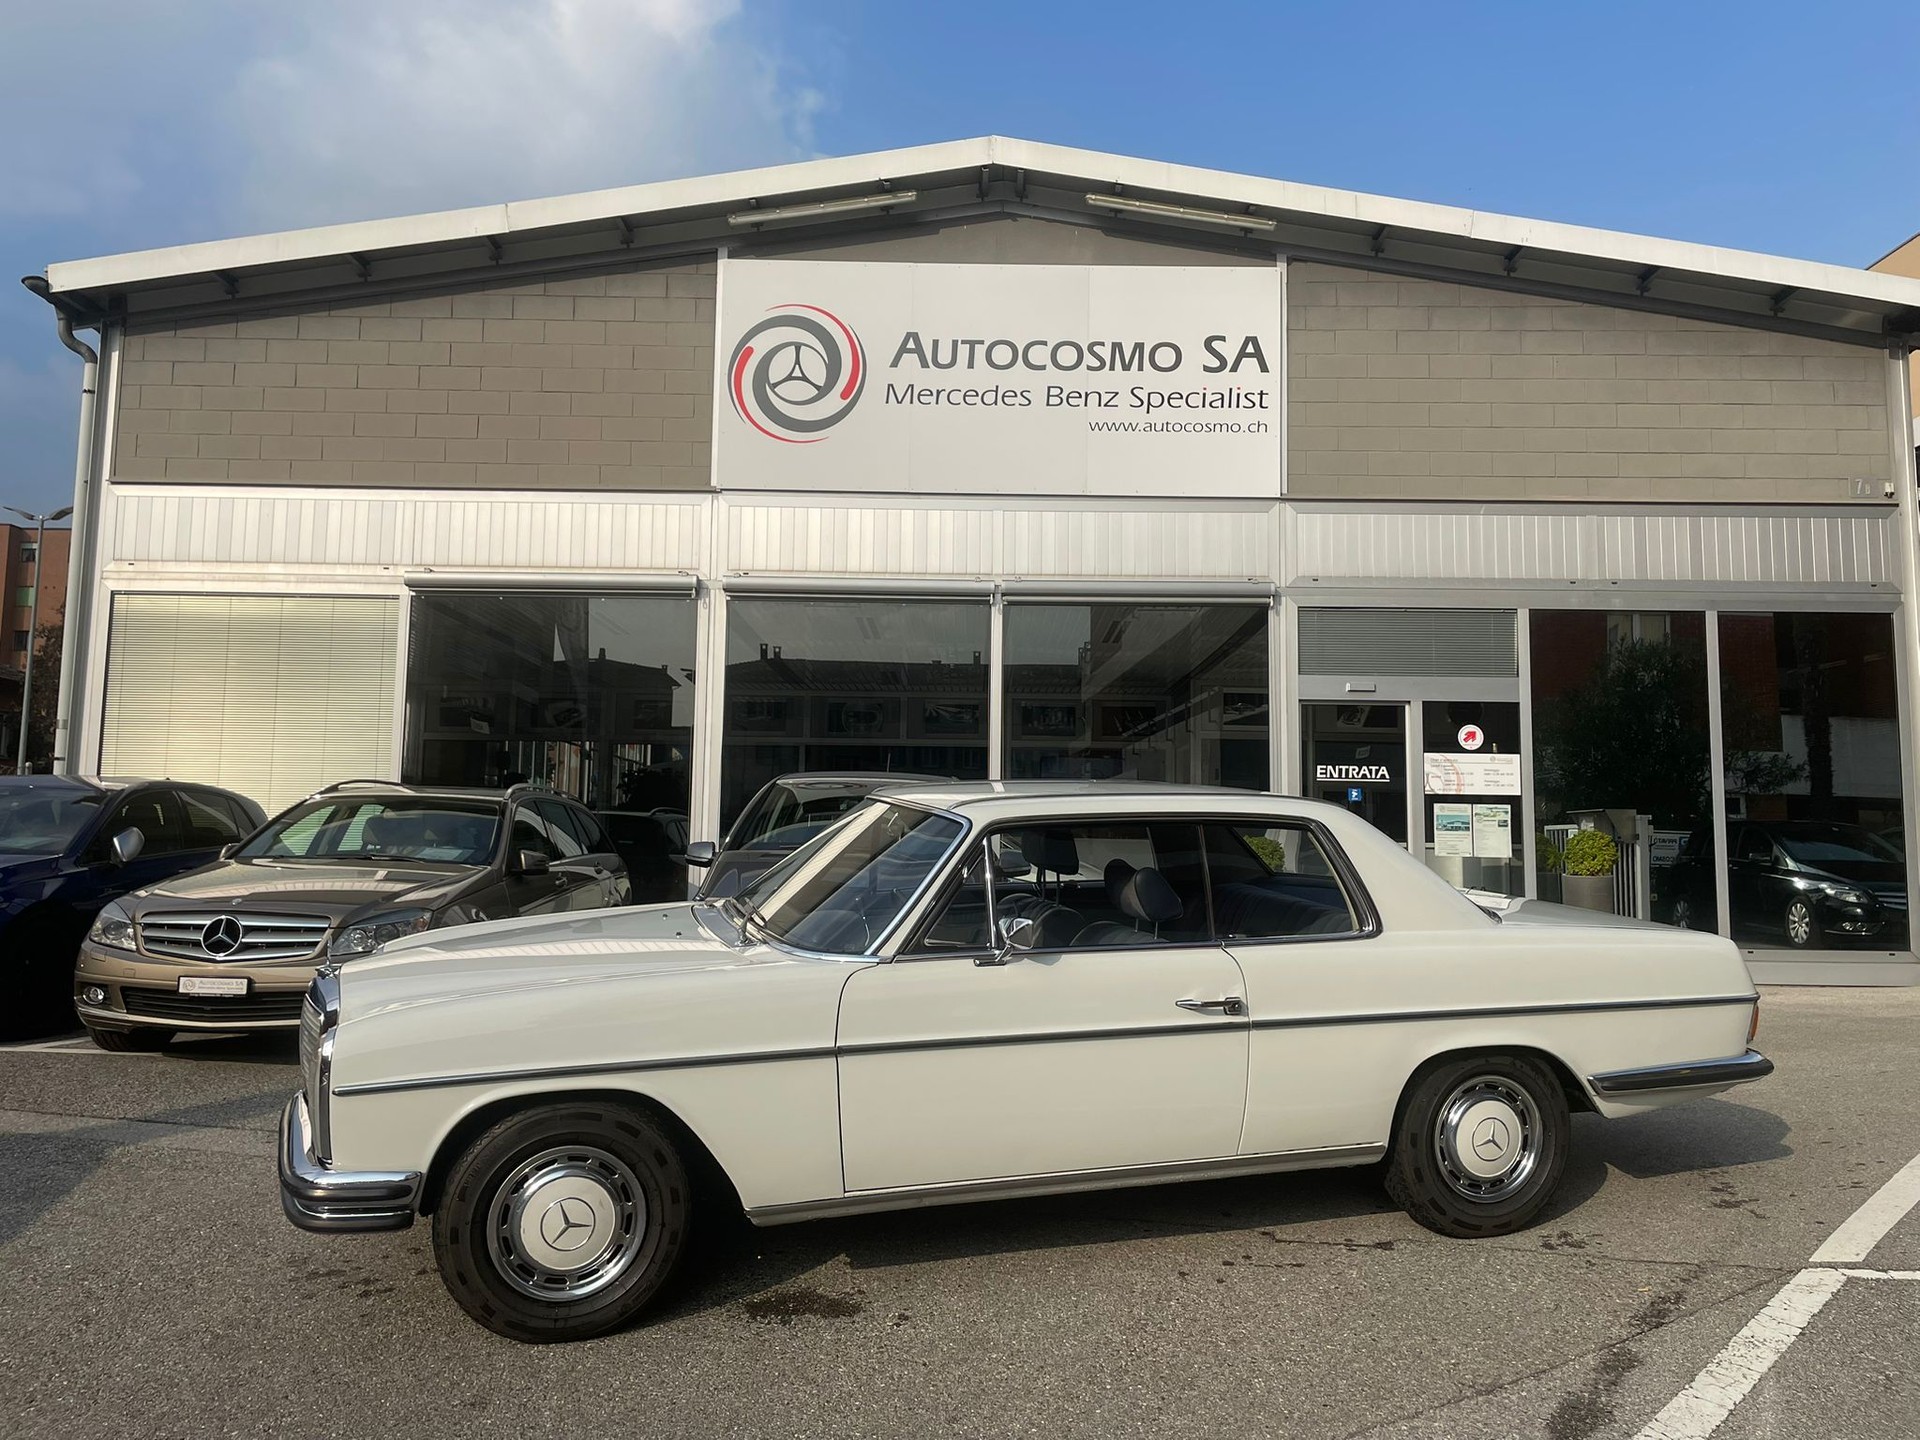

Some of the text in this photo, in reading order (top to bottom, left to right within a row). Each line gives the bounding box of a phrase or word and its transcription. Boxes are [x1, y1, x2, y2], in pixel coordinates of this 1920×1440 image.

[888, 331, 1270, 374] AUTOCOSMO SA
[885, 383, 1269, 415] Mercedes Benz Specialist
[1088, 420, 1268, 434] www.autocosmo.ch
[1316, 765, 1390, 779] ENTRATA
